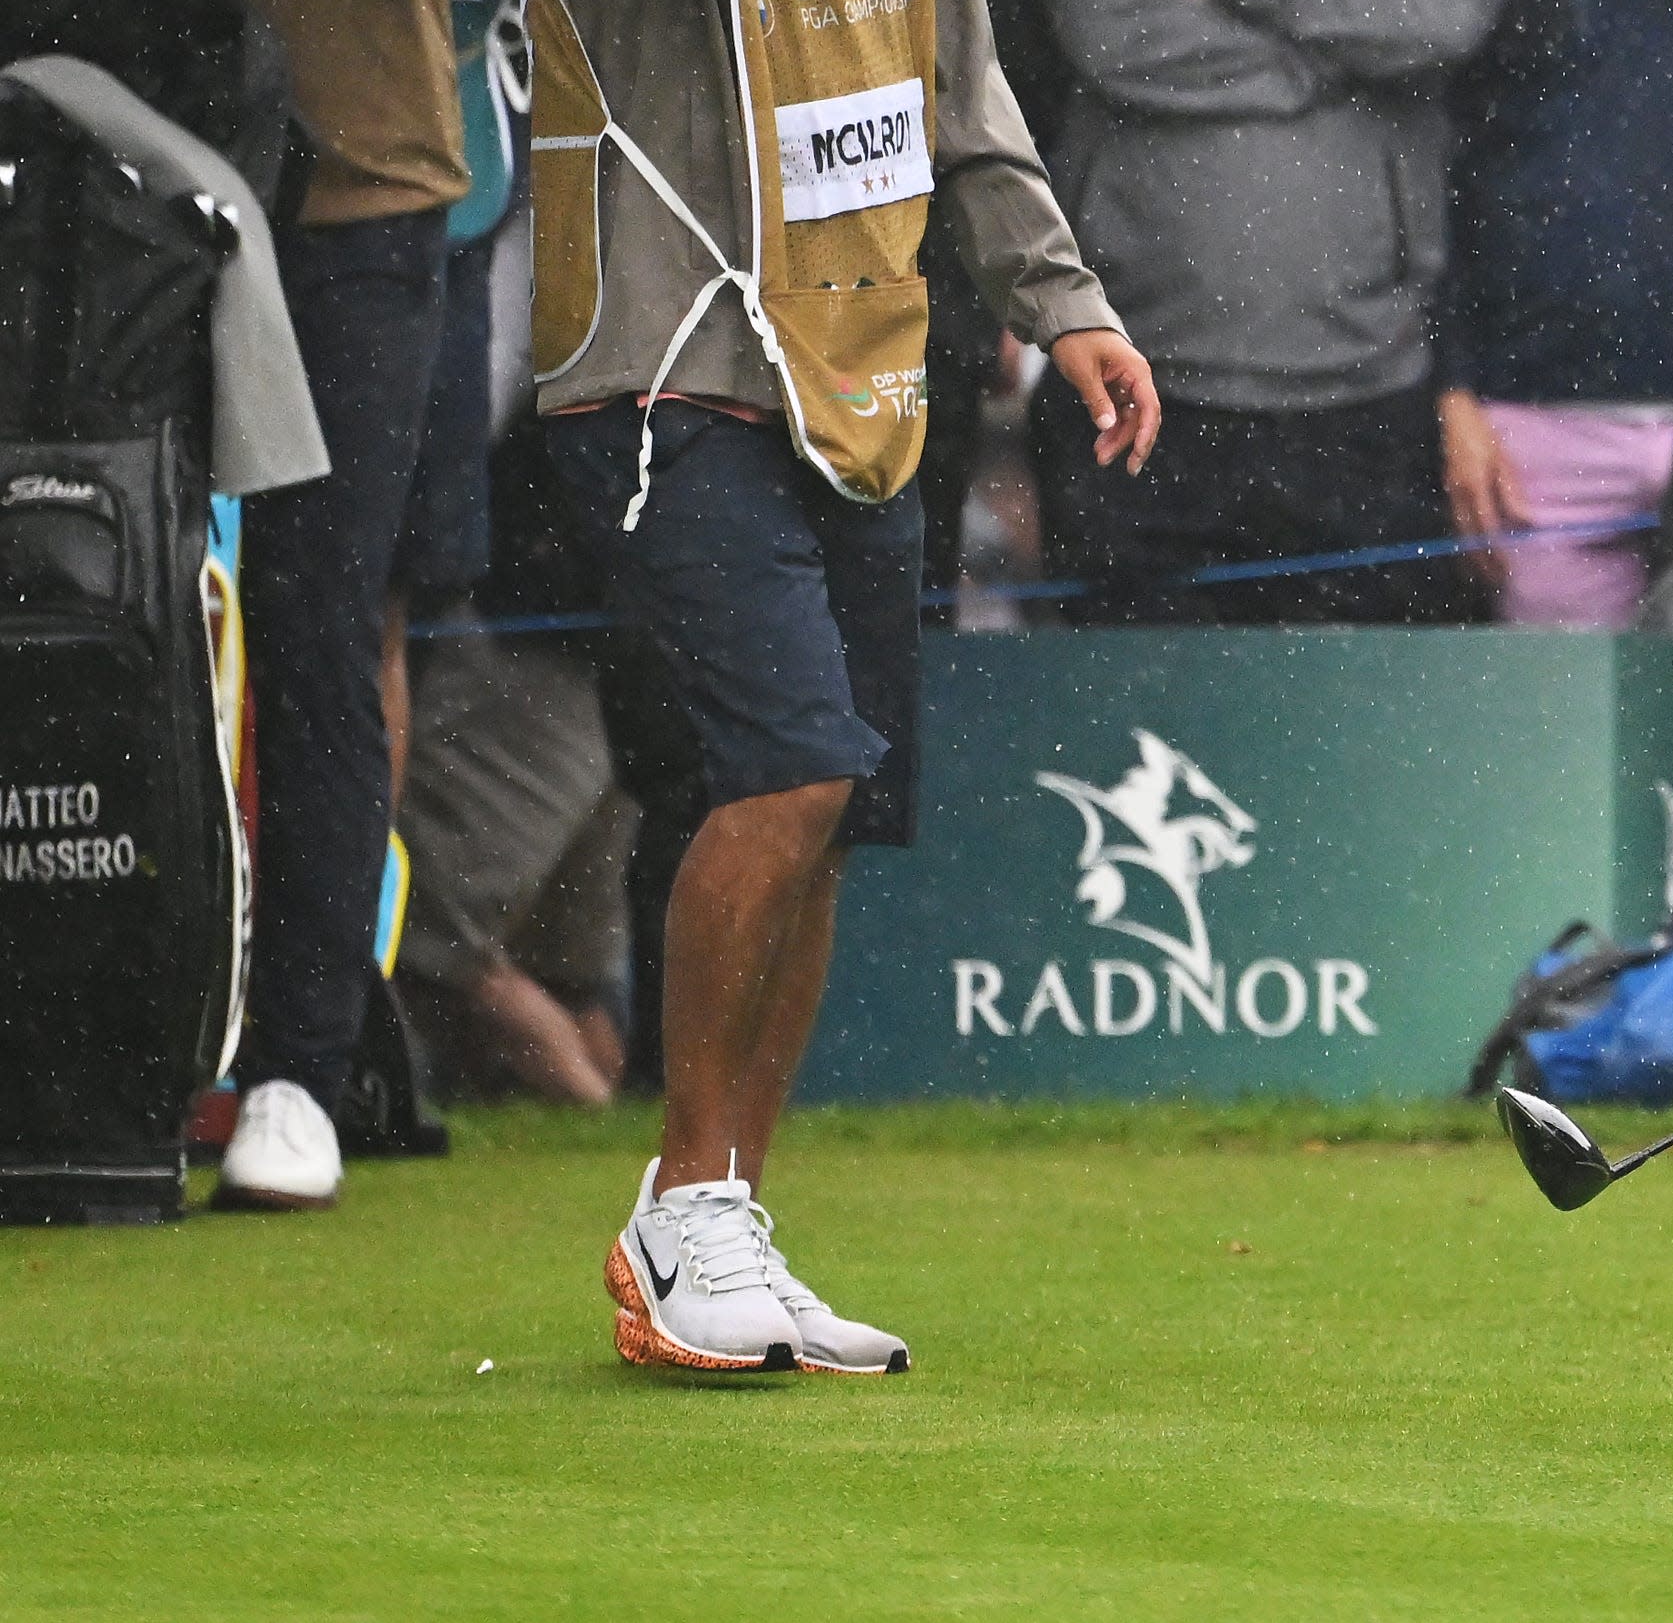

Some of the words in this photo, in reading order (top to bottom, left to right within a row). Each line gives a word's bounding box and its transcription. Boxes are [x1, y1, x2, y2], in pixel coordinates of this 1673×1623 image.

[800, 5, 840, 30] PGA
[0, 781, 100, 830] ATTEO
[951, 957, 1381, 1039] RADNOR
